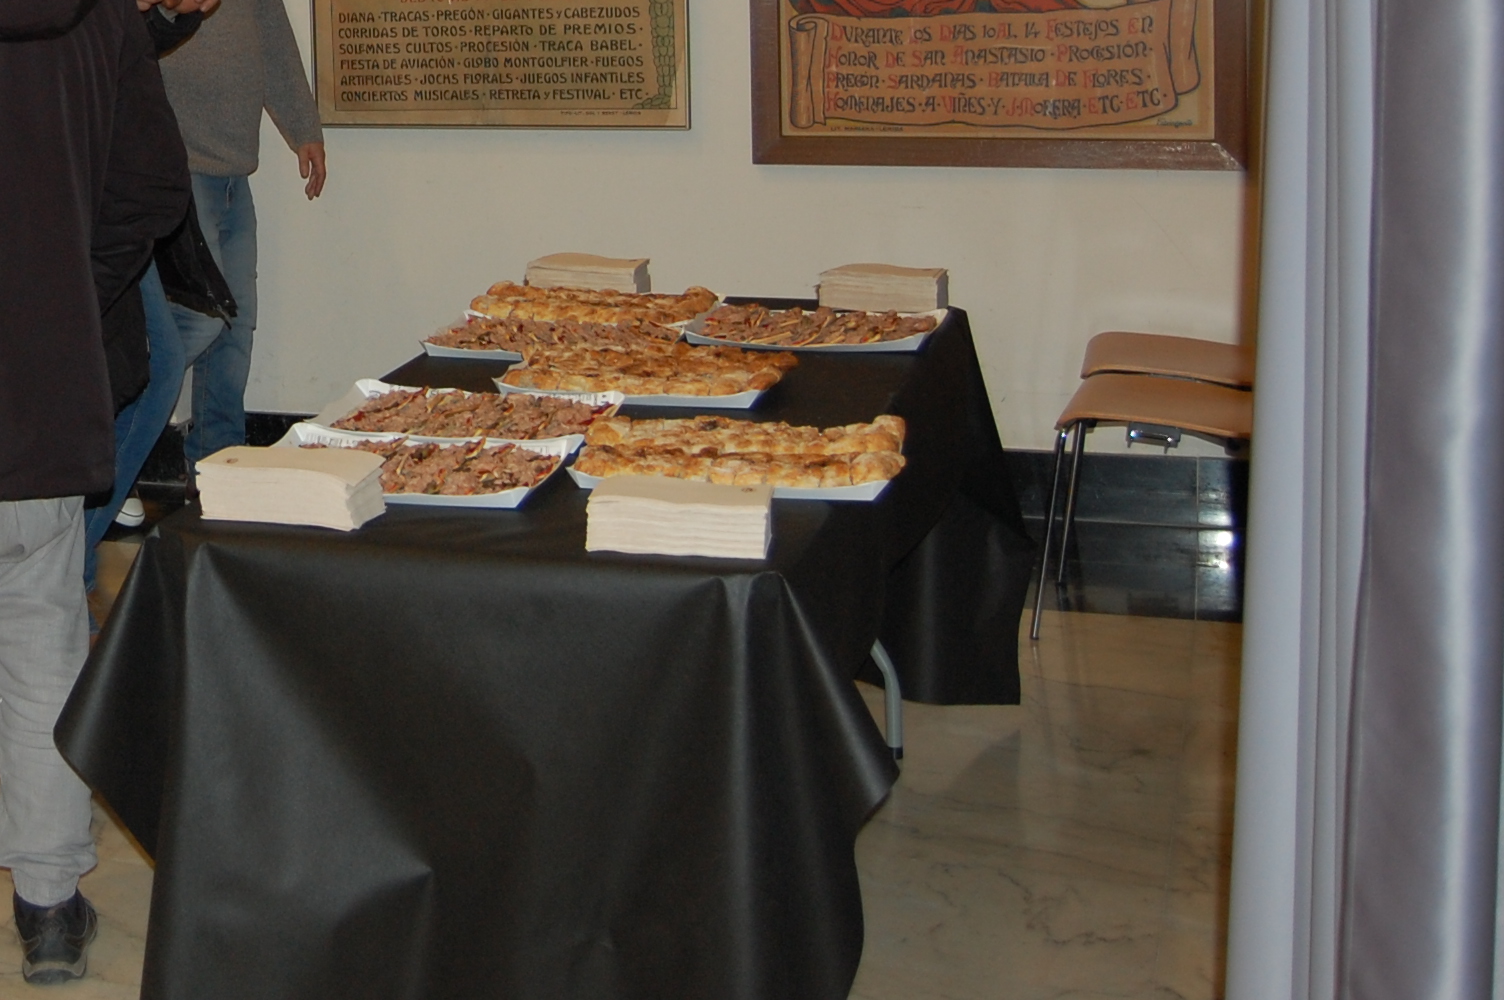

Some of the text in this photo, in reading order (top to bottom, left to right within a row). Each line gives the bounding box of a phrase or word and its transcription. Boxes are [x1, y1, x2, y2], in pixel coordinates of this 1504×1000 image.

[338, 12, 375, 24] DIANA
[381, 10, 430, 22] TRACAS
[492, 8, 554, 20] GIGANTES
[564, 6, 640, 19] CABEZUDOS
[338, 23, 637, 39] CORRIDAS DE TOROS REPARTO DE PREMIOS
[1025, 21, 1041, 40] 14
[339, 43, 401, 55] SOLEMNES
[405, 41, 453, 53] CULTOS
[539, 40, 583, 52] TRACA
[590, 39, 637, 51] BABEL
[340, 59, 380, 70] FIESTA
[383, 58, 396, 70] DE
[463, 57, 499, 68] GLOBO
[503, 56, 588, 68] MONTGOLFIER
[595, 55, 644, 67] FUEGOS
[885, 50, 906, 69] DE
[911, 49, 946, 68] SAN
[340, 71, 645, 86] ARTIFICIALES JOCHS FLORALS JUEGOS INFANTILES
[1055, 69, 1078, 88] DE
[1082, 67, 1143, 88] FLORES
[341, 90, 408, 102] CONCIERTOS
[413, 89, 479, 101] MUSICALES
[489, 88, 541, 100] RETRETA
[552, 88, 611, 100] FESTIVAL
